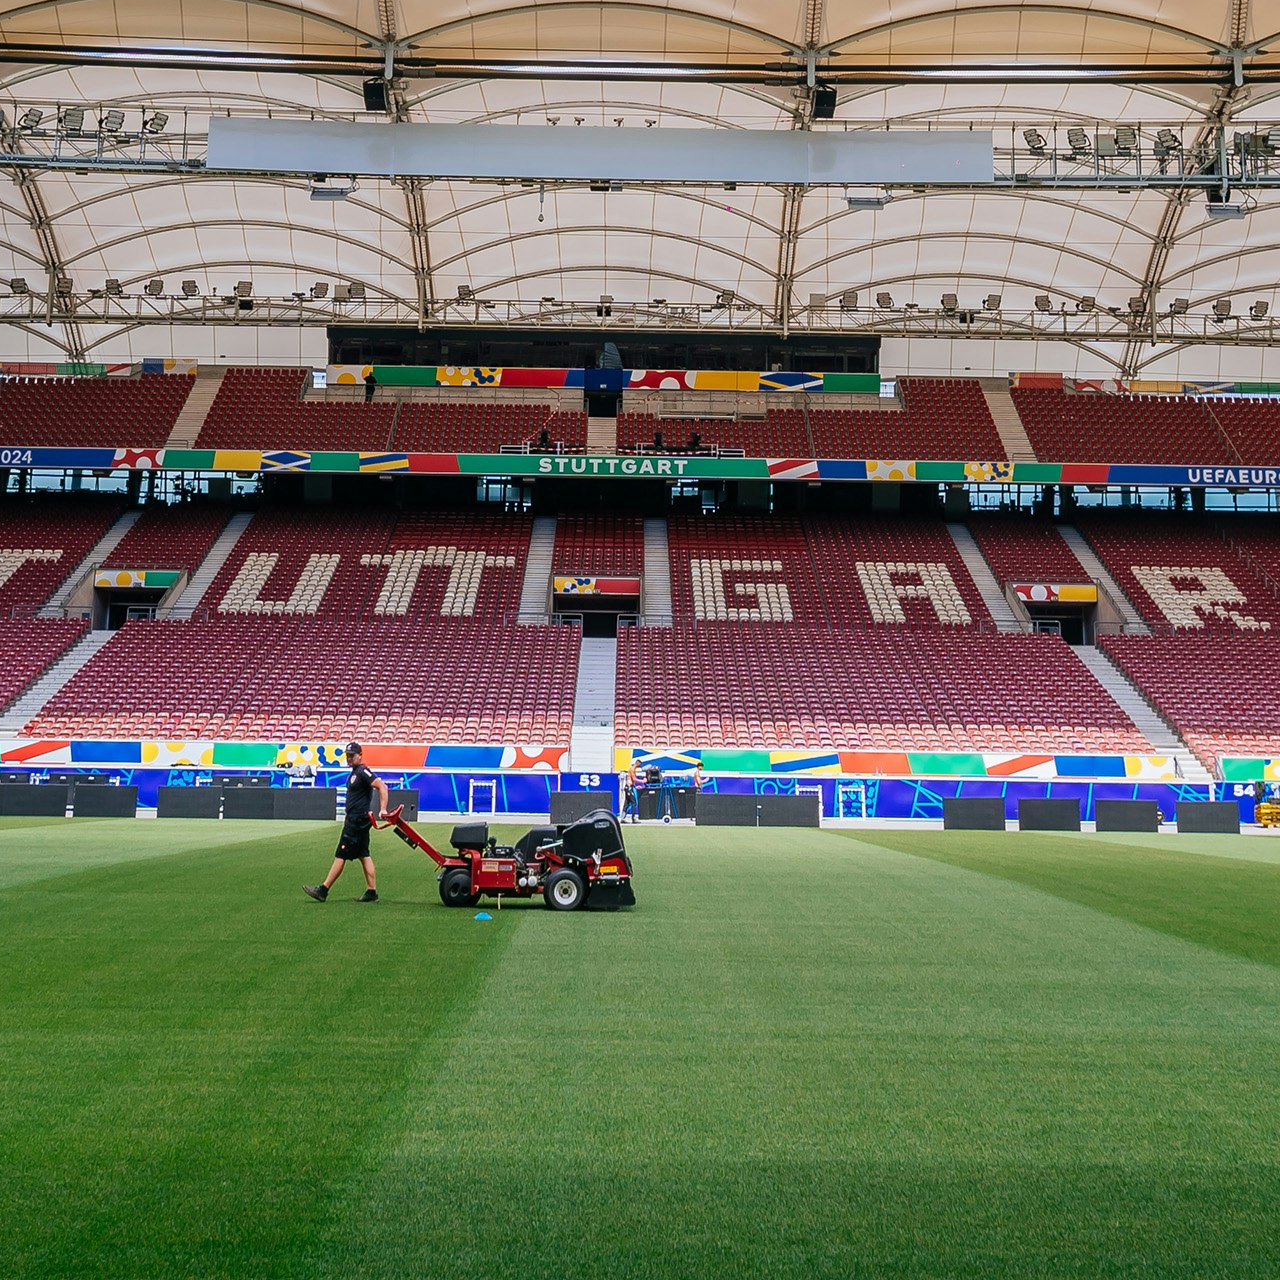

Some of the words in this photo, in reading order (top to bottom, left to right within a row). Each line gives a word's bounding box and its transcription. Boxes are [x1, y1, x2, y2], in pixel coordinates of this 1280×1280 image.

[539, 458, 688, 474] STUTTGART
[579, 774, 600, 787] 53
[1233, 784, 1255, 797] 54
